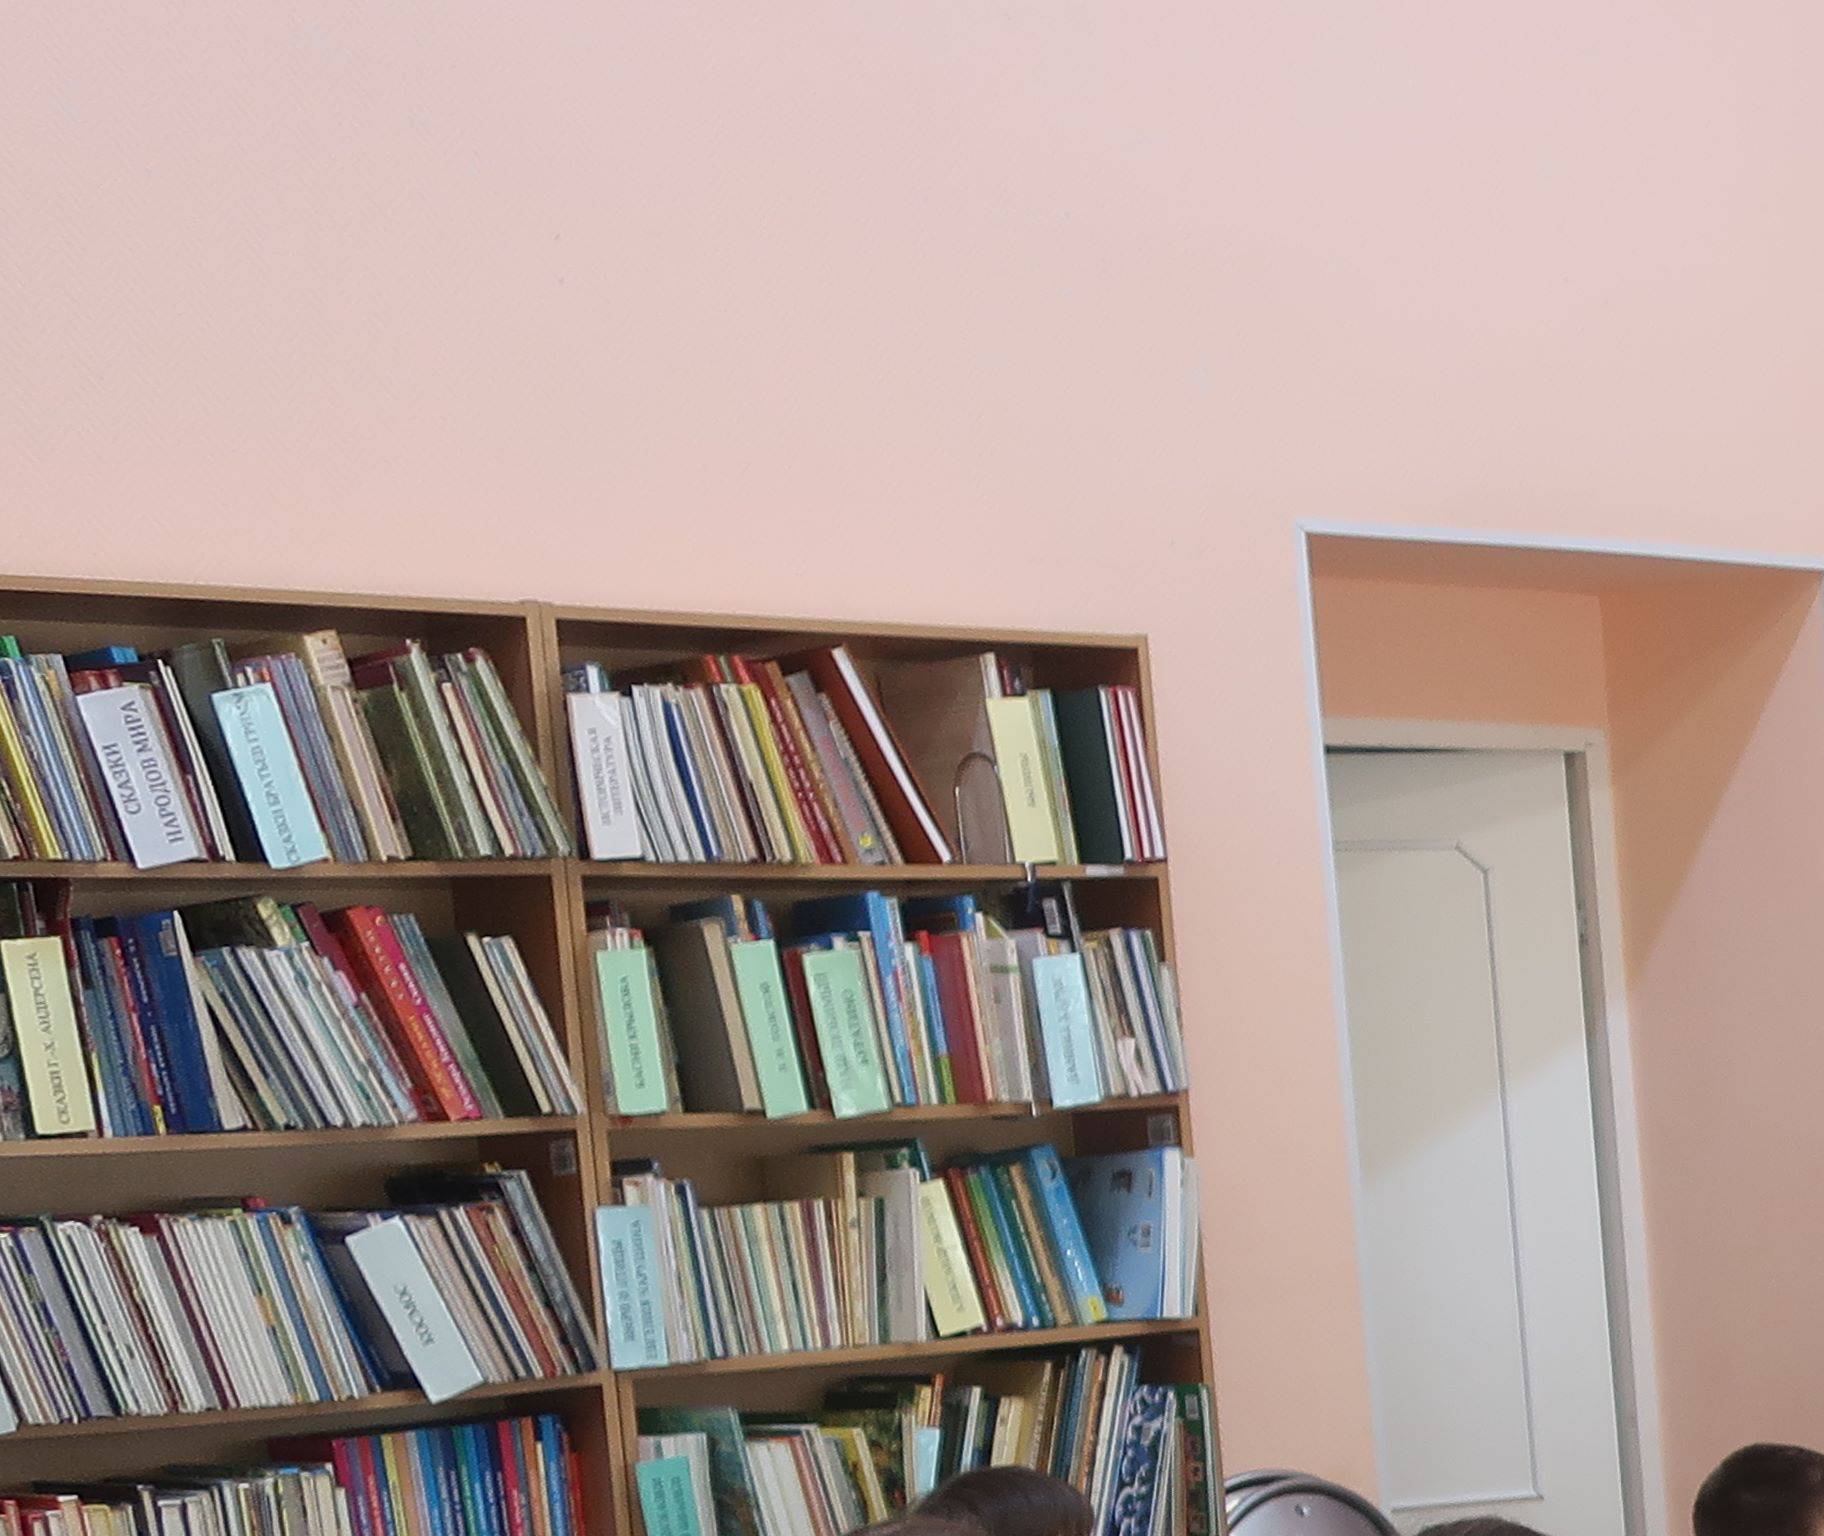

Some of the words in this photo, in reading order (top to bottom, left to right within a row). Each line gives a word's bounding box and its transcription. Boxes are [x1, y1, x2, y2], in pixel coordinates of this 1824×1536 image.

[120, 700, 153, 753] МИРА
[102, 742, 142, 815] СКАЗКИ
[141, 757, 185, 844] НАРОДОВ
[26, 951, 53, 1036] АНДЕРСЕНА
[50, 1071, 71, 1125] СКАЗКИ
